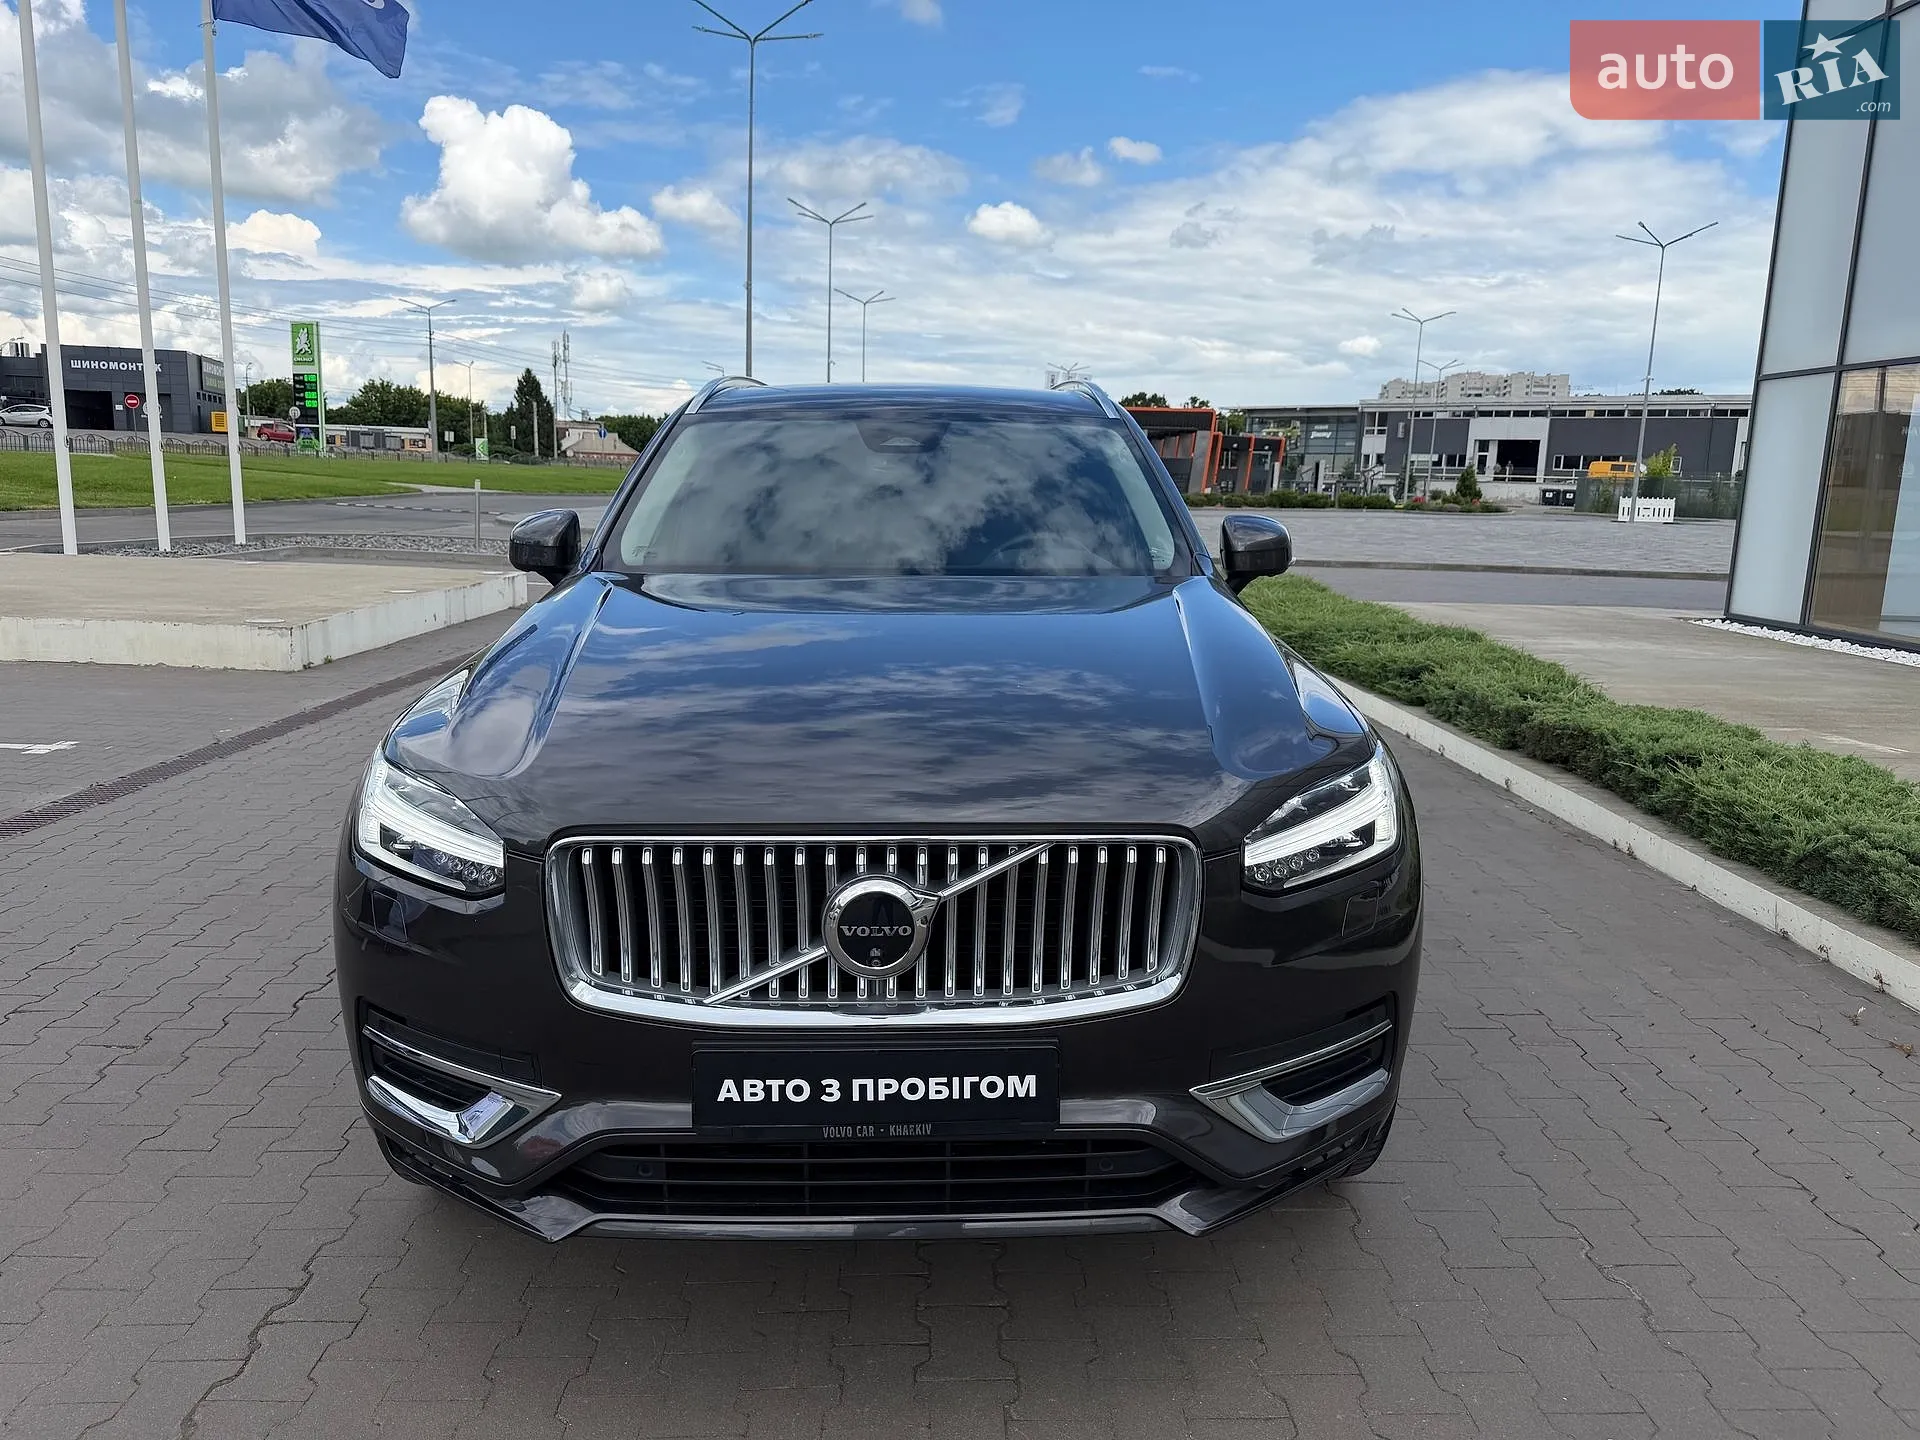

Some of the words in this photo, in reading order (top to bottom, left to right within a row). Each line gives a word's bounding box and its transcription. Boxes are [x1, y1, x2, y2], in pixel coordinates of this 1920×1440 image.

[70, 359, 162, 373] ШИНОМОНТЖ
[840, 925, 912, 936] VOLVO
[717, 1078, 810, 1102] АВТО
[852, 1075, 1037, 1102] ПРОБІГОМ
[822, 1126, 853, 1138] VOLVO
[856, 1124, 875, 1137] CAR
[889, 1123, 932, 1136] KHARKIV
